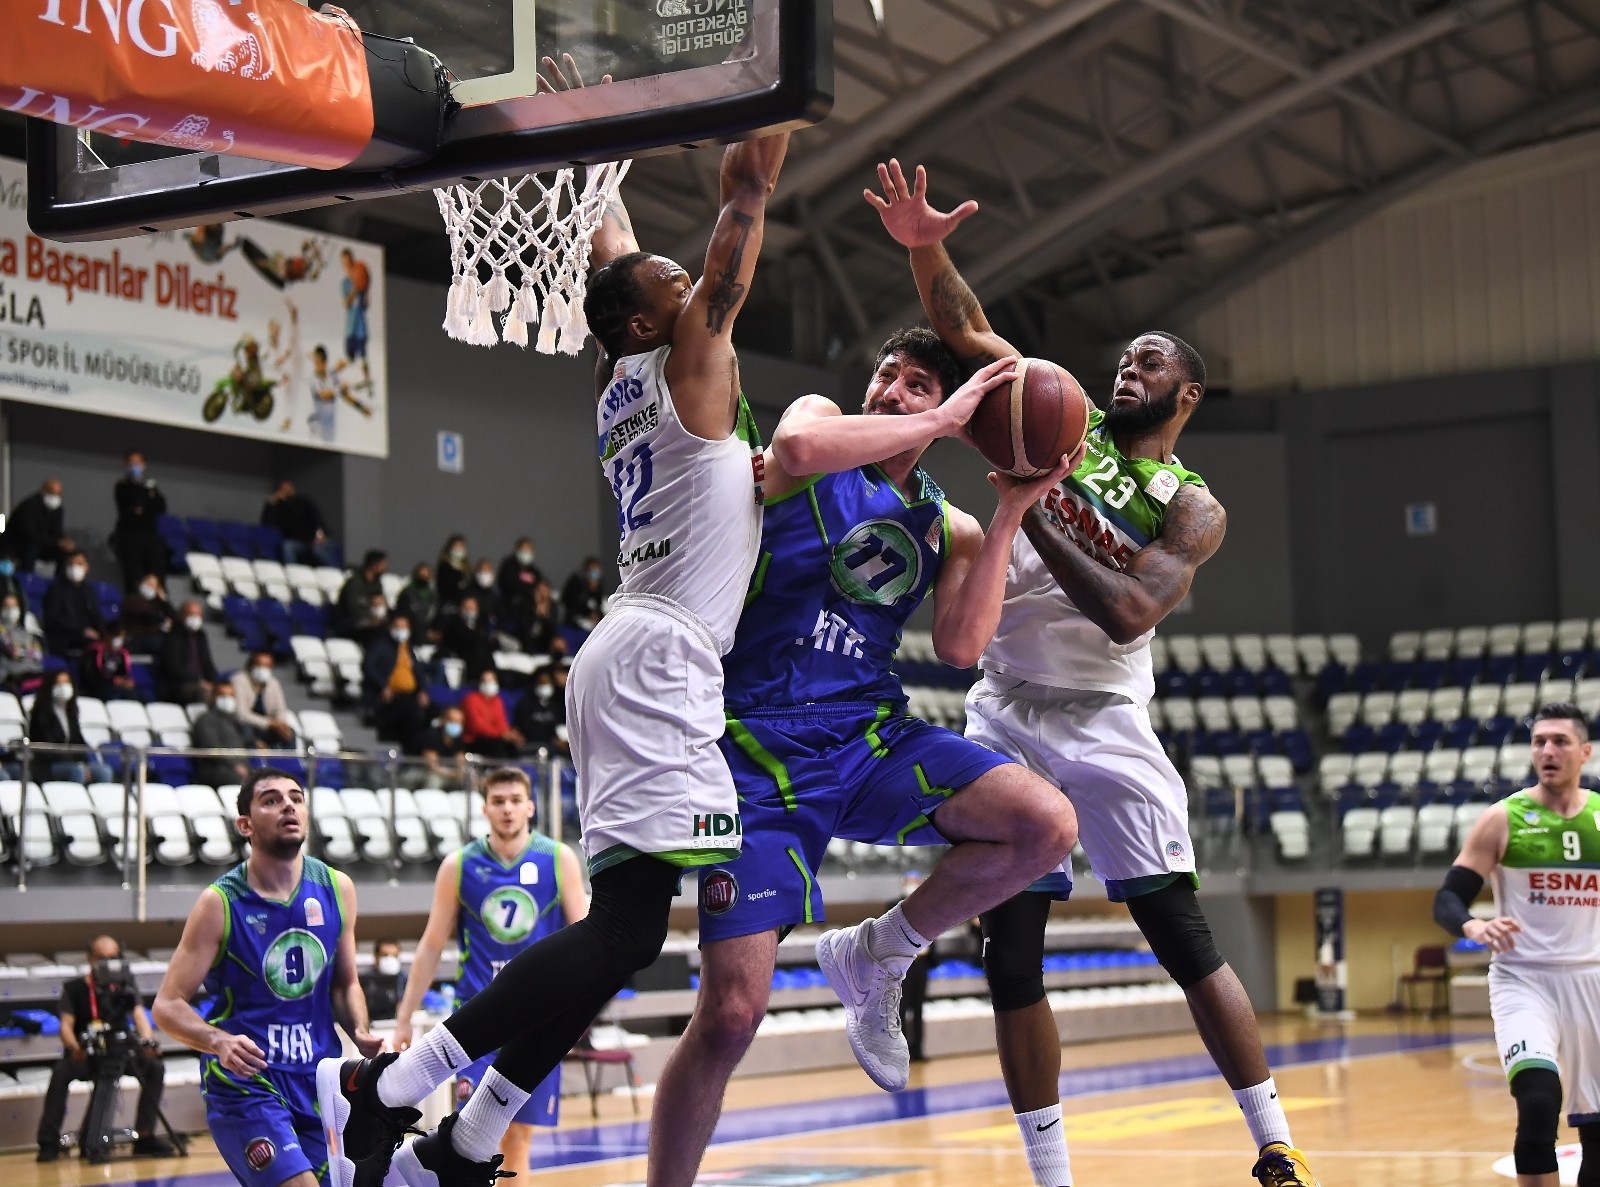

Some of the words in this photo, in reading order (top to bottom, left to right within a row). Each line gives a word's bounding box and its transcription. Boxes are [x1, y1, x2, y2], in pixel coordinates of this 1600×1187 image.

[26, 234, 148, 304] Başarılar
[155, 263, 239, 321] Dileriz
[8, 337, 59, 370] SPOR
[1081, 455, 1138, 510] 23
[843, 533, 908, 593] 77
[693, 813, 741, 837] HDI
[1562, 831, 1581, 861] 9
[706, 880, 728, 905] FIAT
[747, 888, 777, 901] sportive
[1528, 872, 1598, 892] ESNA
[501, 899, 518, 928] 7
[285, 945, 305, 984] 9
[1504, 1040, 1526, 1066] HDI
